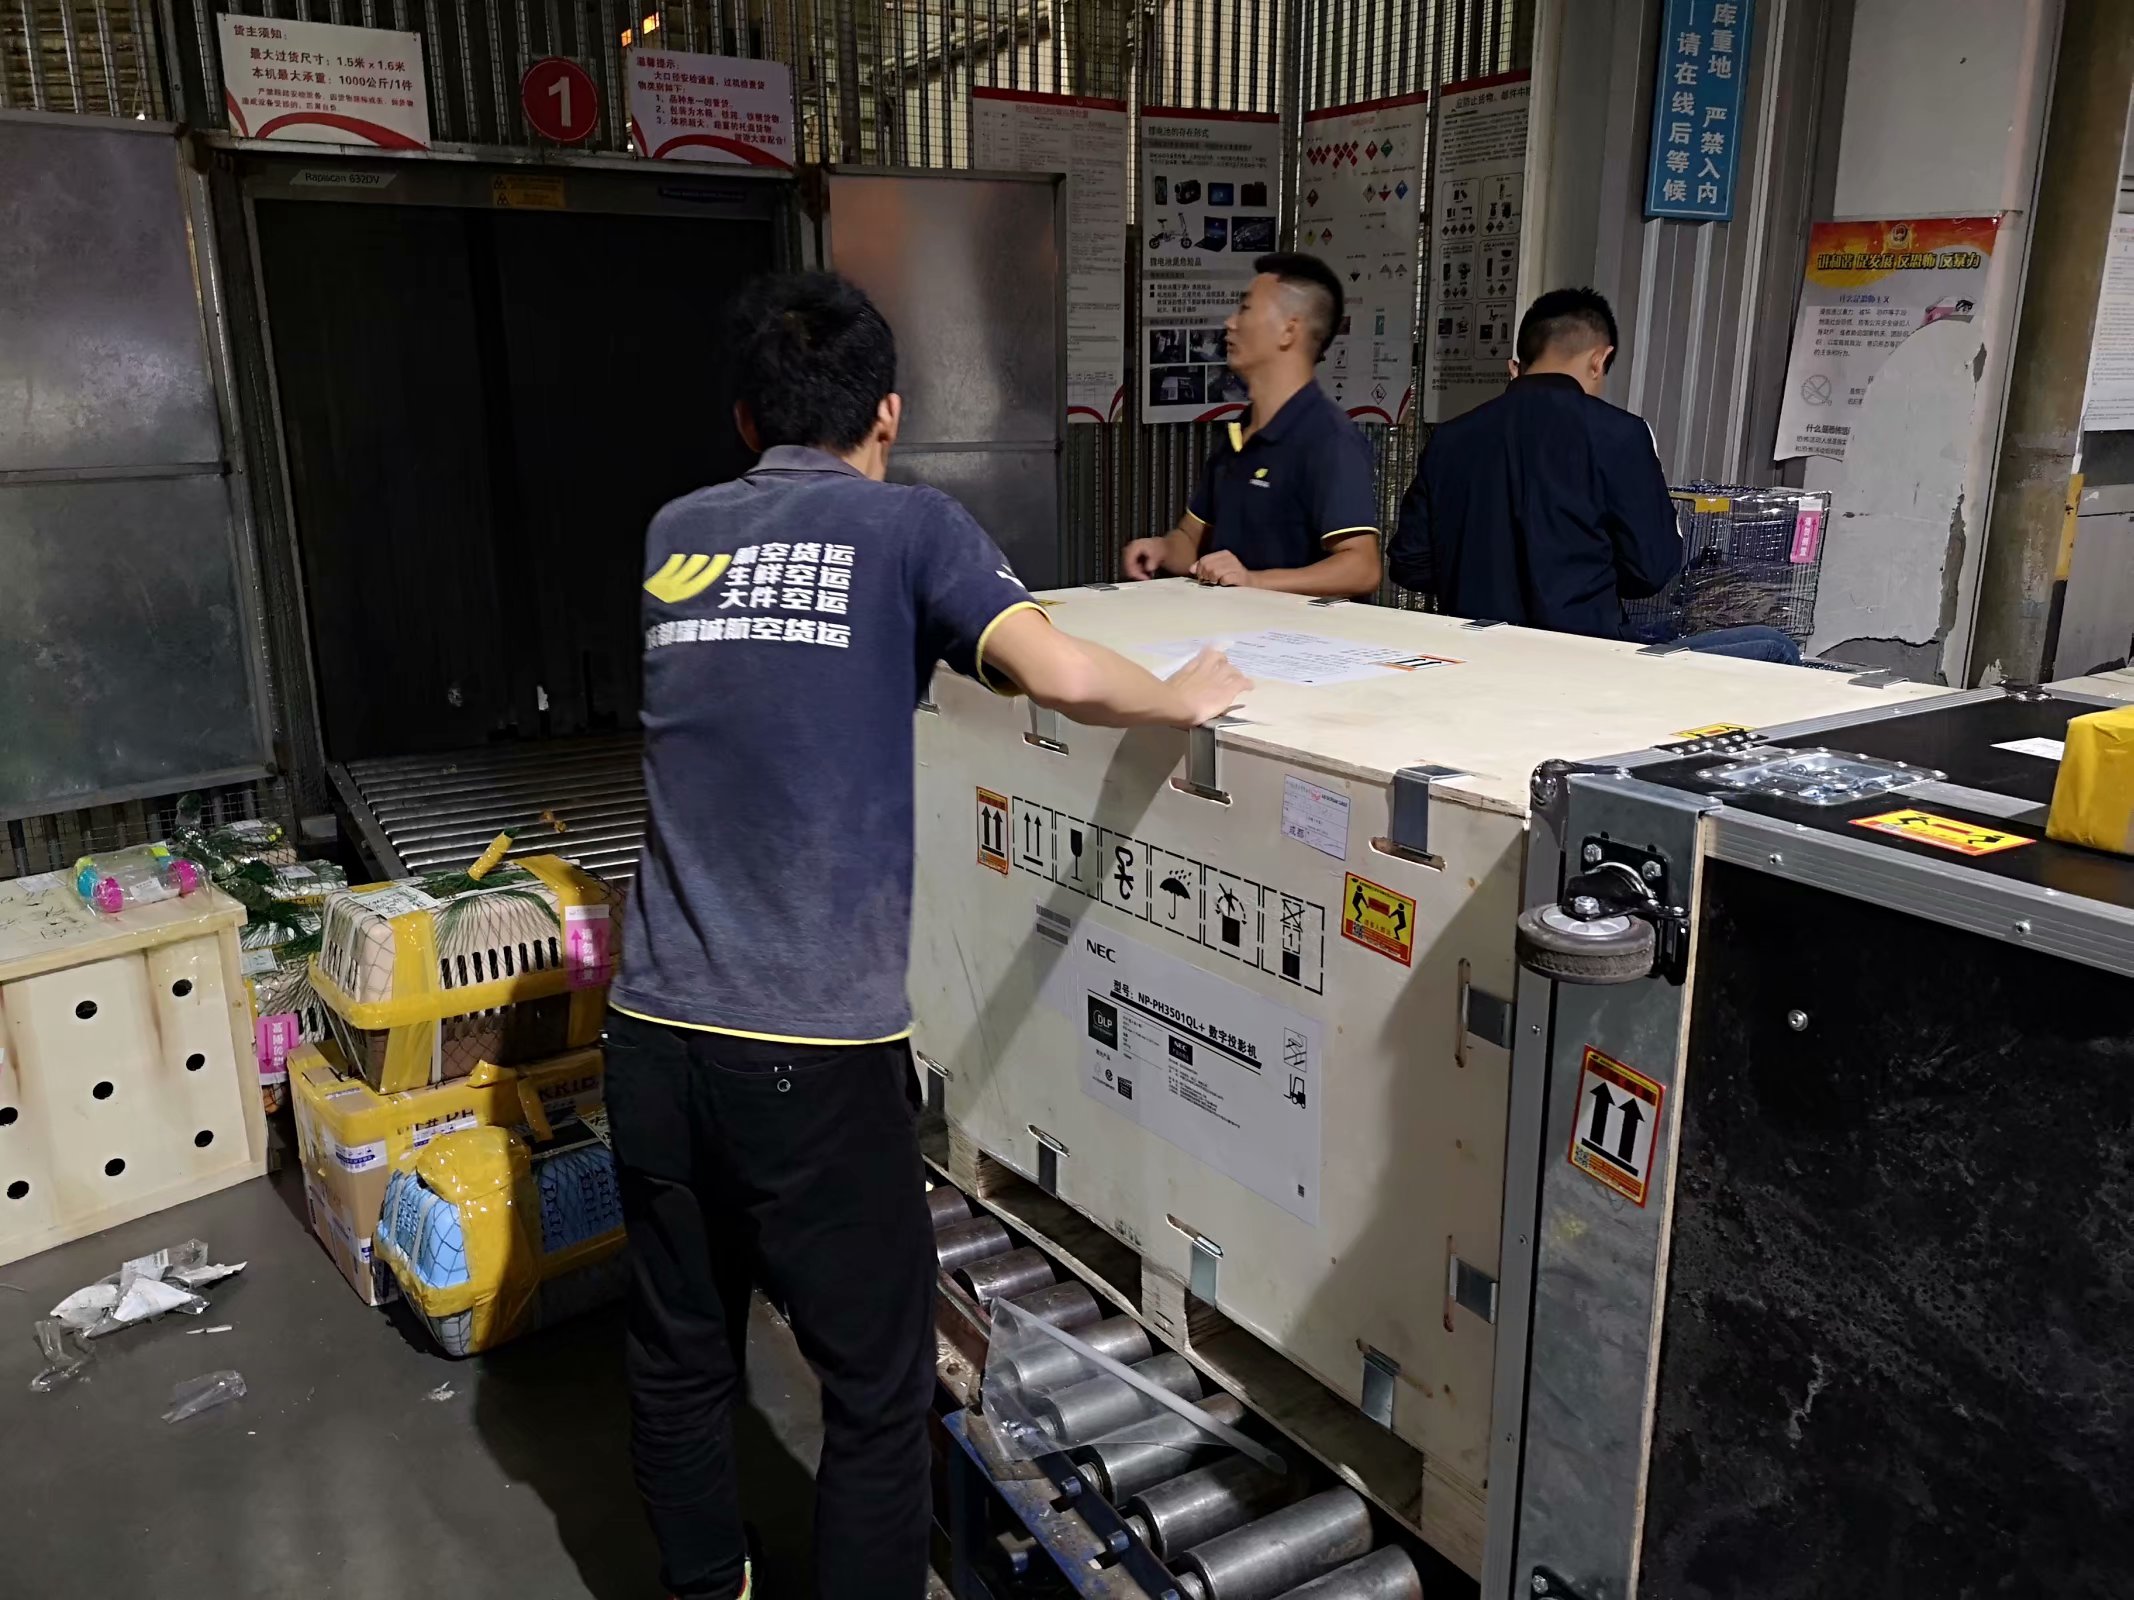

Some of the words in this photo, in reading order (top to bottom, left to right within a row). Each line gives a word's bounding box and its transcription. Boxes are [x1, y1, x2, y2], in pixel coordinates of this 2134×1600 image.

[1708, 0, 1738, 79] 库重地
[548, 75, 572, 128] 1
[1696, 106, 1728, 204] 严禁入内
[1817, 253, 1853, 271] 讲和谐
[1855, 252, 1895, 271] 促发展
[1895, 252, 1936, 270] 反恐怖
[1938, 251, 1981, 270] 反暴力
[731, 541, 856, 567] 航空货运
[724, 563, 852, 591] 生鲜空运
[717, 585, 850, 615] 大件空运
[1086, 938, 1116, 964] NEC
[1097, 1014, 1113, 1028] DLP
[1208, 1024, 1258, 1060] 数字投影机
